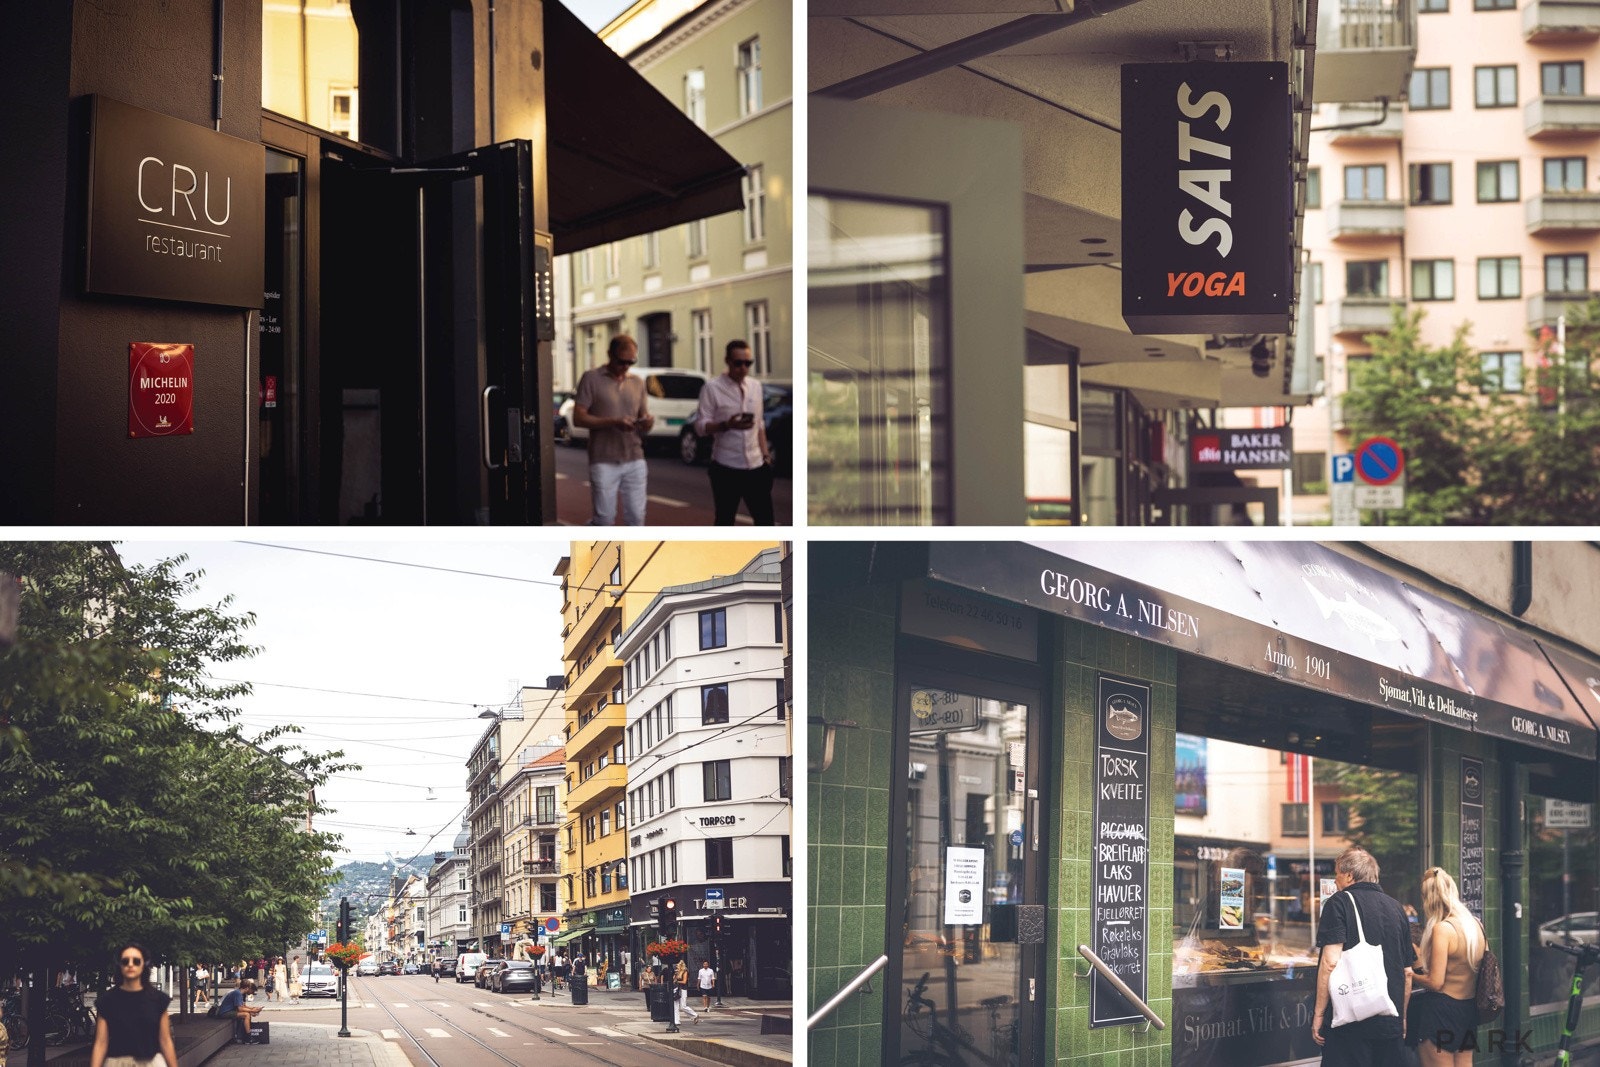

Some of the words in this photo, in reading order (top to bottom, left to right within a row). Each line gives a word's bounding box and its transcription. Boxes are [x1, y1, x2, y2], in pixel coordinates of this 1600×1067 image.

[1177, 81, 1233, 259] SATS
[138, 156, 231, 226] CRU
[146, 235, 222, 262] restaurant
[1167, 271, 1246, 297] YOGA
[140, 377, 188, 389] MICHELIN
[155, 393, 176, 405] 2020
[1231, 433, 1283, 448] BAKER
[1223, 449, 1290, 464] HANSEN
[1336, 456, 1353, 481] P
[1040, 569, 1112, 612] GEORG
[1116, 593, 1133, 619] A.
[1137, 599, 1200, 639] NILSEN
[1263, 640, 1297, 670] Anno.
[1305, 654, 1331, 680] 1901
[1427, 693, 1436, 711] &
[1437, 695, 1478, 722] Delikatesse
[1511, 716, 1538, 737] GEORG
[1546, 725, 1571, 745] NILSEN
[1101, 754, 1139, 779] TORSK
[1100, 782, 1144, 800] KVEITE
[699, 815, 736, 827] TORP&CO
[1103, 864, 1132, 880] LAKS
[1097, 907, 1145, 921] FJELLØRRET
[1102, 926, 1142, 943] Røkelaks
[1100, 943, 1139, 960] Gravlaks
[1279, 1006, 1291, 1031] &
